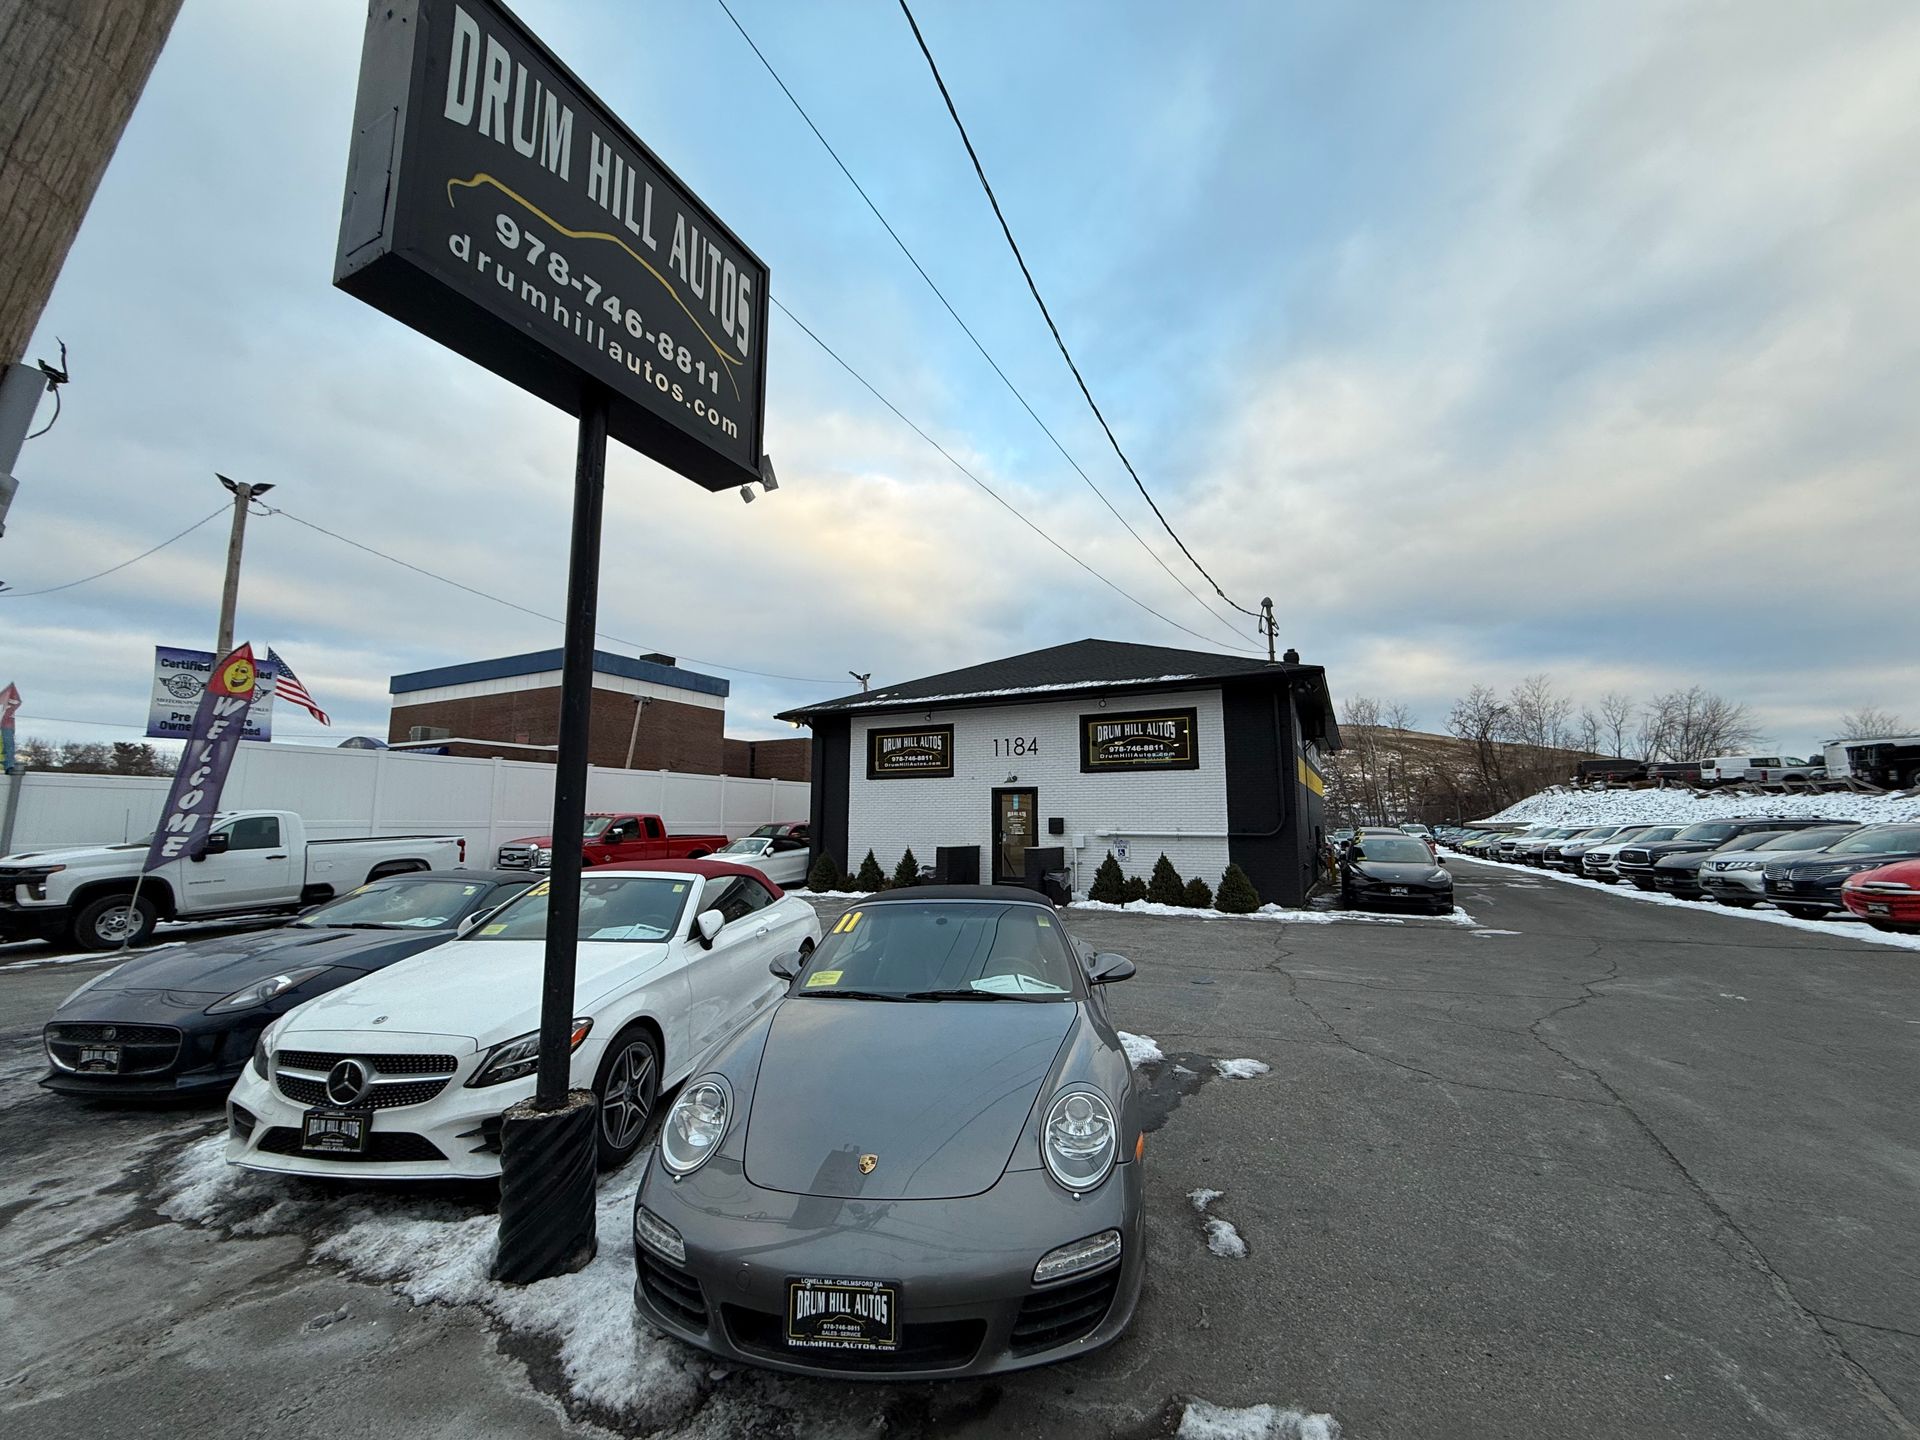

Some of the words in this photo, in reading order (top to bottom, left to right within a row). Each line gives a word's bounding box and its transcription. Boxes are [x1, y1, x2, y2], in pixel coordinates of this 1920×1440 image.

[443, 3, 574, 183] DRUM
[586, 131, 657, 252] HILL
[668, 211, 751, 359] AUTOS
[495, 213, 720, 395] 978-746-8811
[448, 232, 738, 440] drumhillautos.com
[161, 658, 211, 672] Certified
[160, 721, 192, 731] Owne
[171, 711, 191, 722] Pre
[1097, 724, 1121, 743] DRUM
[1124, 723, 1143, 736] HILL
[1146, 721, 1176, 739] AUTOS
[883, 737, 902, 753] DRUM
[903, 736, 918, 747] HILL
[920, 735, 942, 750] AUTOS
[993, 736, 1039, 757] 1184
[1109, 744, 1164, 753] 978-746-8811
[161, 696, 247, 858] WELCOME
[836, 1280, 873, 1288] CHELMSFORD
[796, 1290, 826, 1320] DRUM
[828, 1292, 851, 1313] HILL
[854, 1293, 888, 1325] AUTOS
